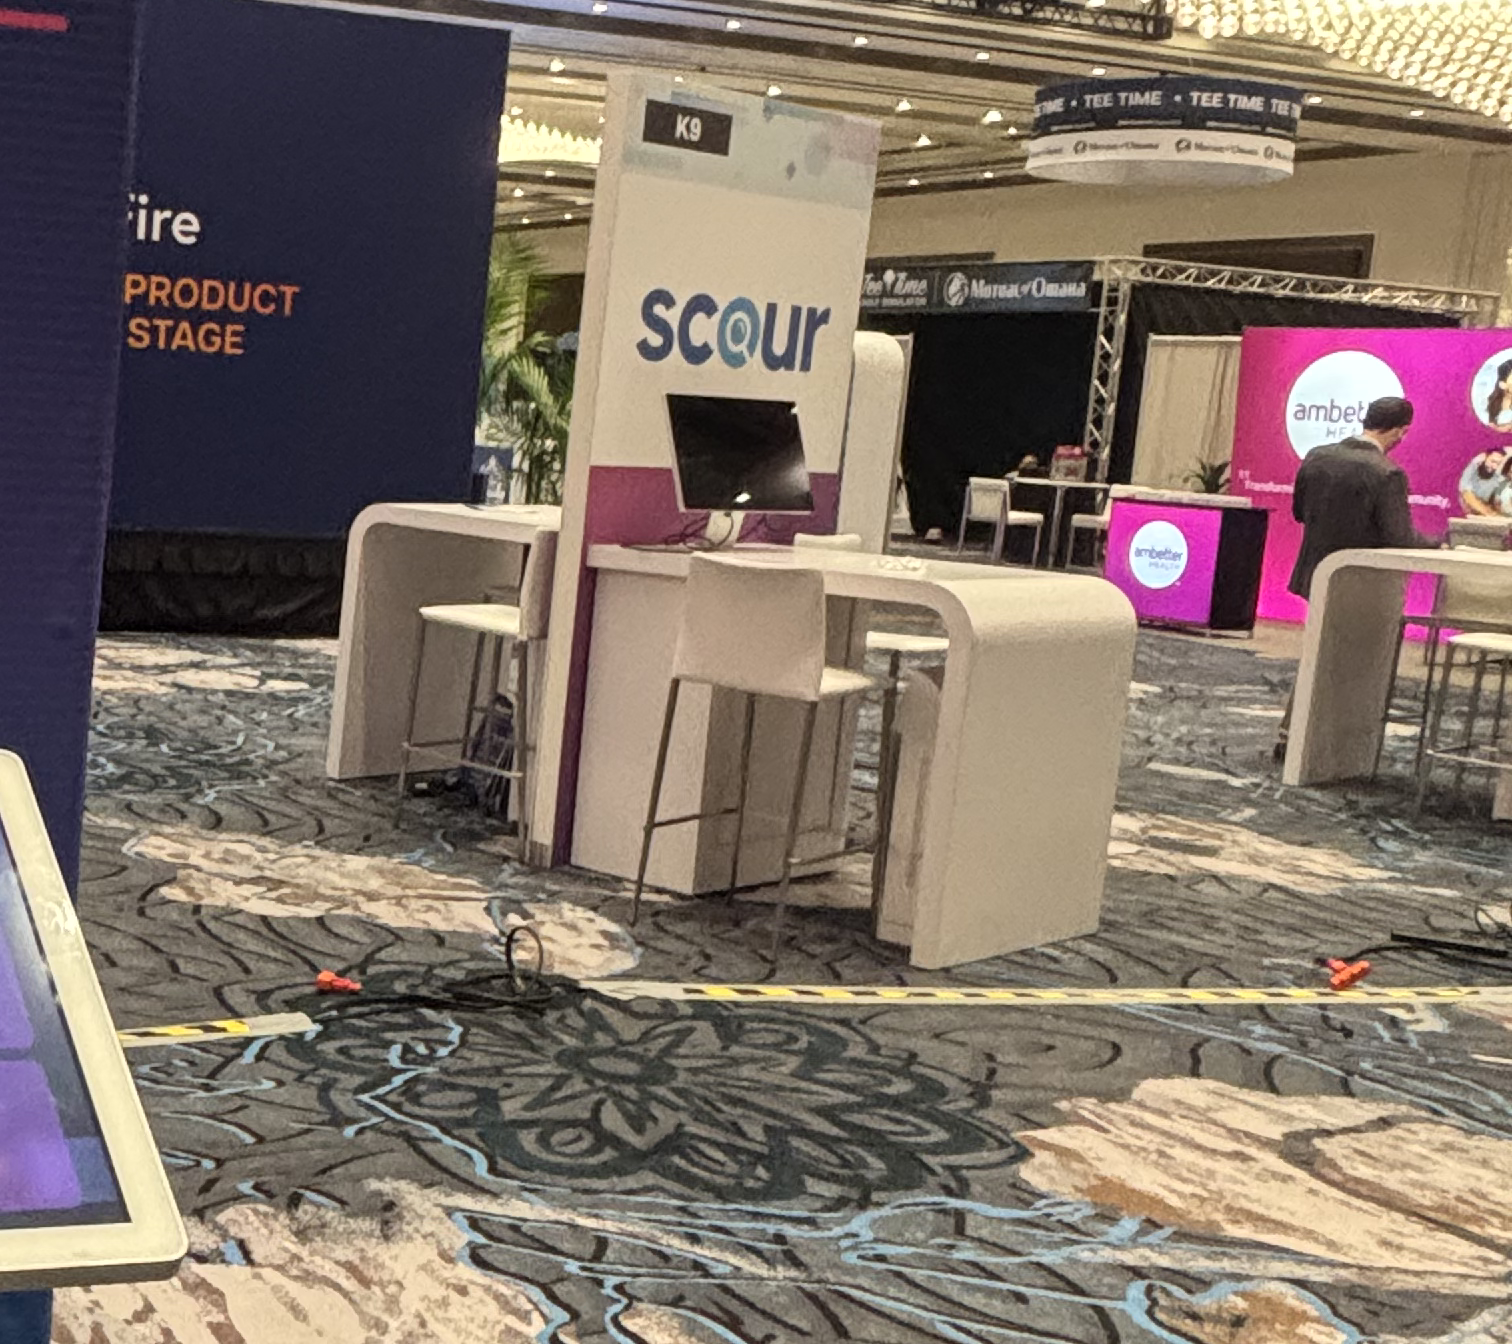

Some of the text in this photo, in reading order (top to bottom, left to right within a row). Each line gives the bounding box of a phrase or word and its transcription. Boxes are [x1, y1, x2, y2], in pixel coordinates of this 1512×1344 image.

[1084, 90, 1163, 108] TEE TIME
[1190, 91, 1265, 112] TEE TIME
[675, 113, 702, 142] K9
[129, 193, 201, 245] ire
[123, 273, 301, 317] PRODUCT
[127, 316, 245, 354] STAGE
